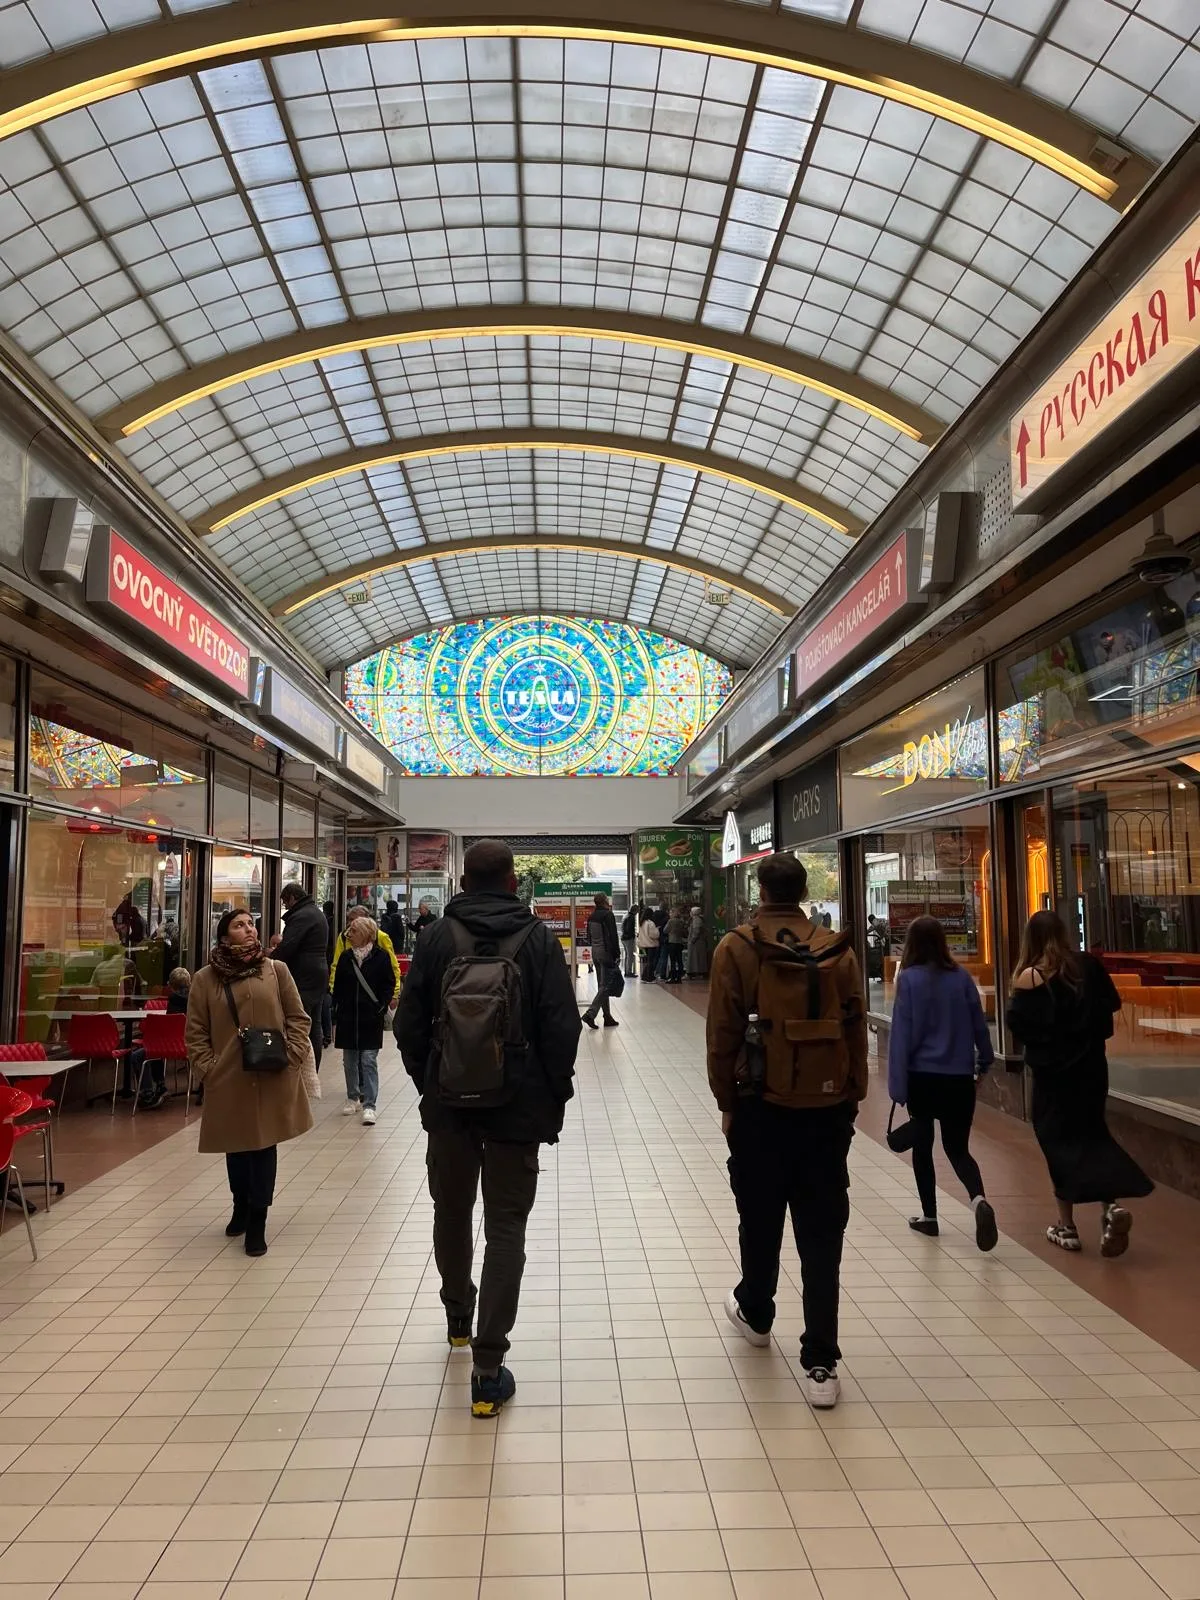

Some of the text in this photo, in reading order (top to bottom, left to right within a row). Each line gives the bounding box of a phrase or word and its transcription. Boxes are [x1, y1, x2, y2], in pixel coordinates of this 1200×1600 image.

[1040, 289, 1169, 458] РУССКАЯ
[113, 554, 247, 682] OVOCNÝ SVĚTOZOR
[352, 592, 365, 602] EXIT
[711, 593, 724, 603] EXIT
[846, 567, 891, 635] KANCELÁŘ
[793, 784, 820, 822] CARYS
